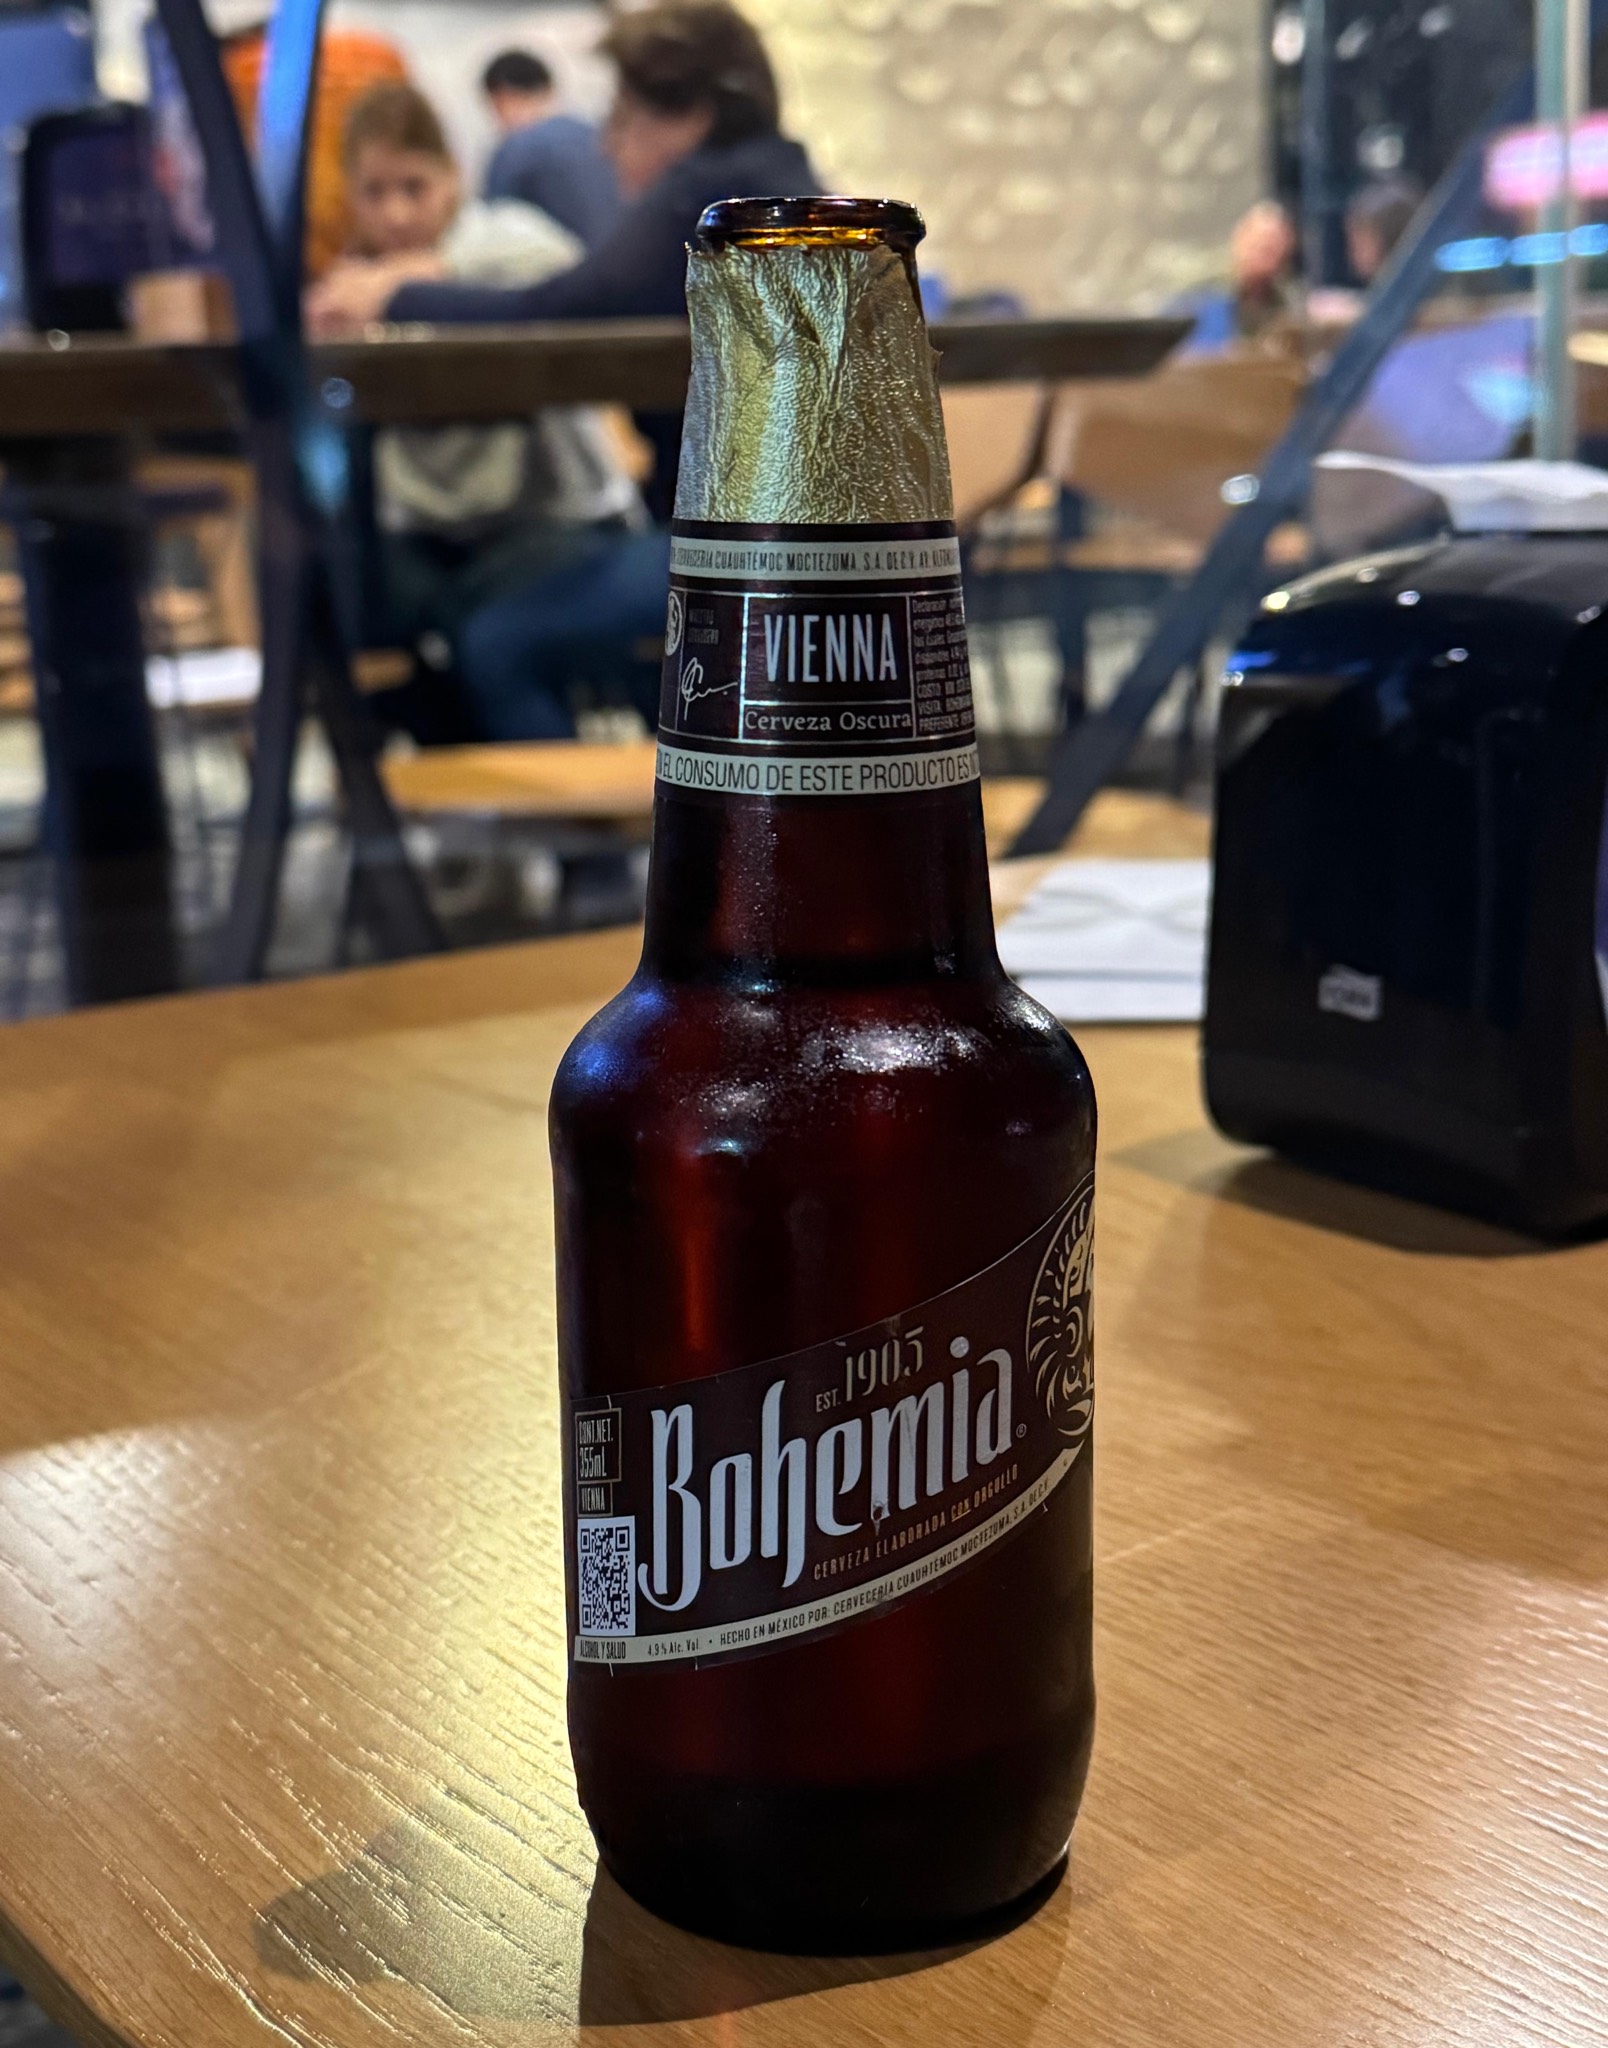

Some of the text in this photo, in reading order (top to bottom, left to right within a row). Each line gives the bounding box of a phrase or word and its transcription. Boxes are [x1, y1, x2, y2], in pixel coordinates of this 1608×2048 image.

[764, 613, 897, 682] VIENNA
[744, 710, 913, 732] Cerveza Oscura
[663, 753, 673, 779] EL
[675, 756, 761, 790] CONSUMO
[766, 765, 794, 791] DE
[800, 765, 854, 792] ESTE
[859, 756, 956, 791] PRODUCTO
[957, 753, 970, 780] ES
[815, 1325, 924, 1413] EST. 1905
[581, 1487, 606, 1512] VIENNA
[637, 1335, 1013, 1612] Bohemia
[814, 1547, 870, 1581] CERVEZA
[876, 1511, 946, 1558] ELABORADA
[973, 1463, 1019, 1508] ORGULLO
[600, 1641, 606, 1659] Y
[606, 1641, 626, 1660] SALUD
[669, 1641, 684, 1654] Alc.
[720, 1629, 751, 1646] HECHO
[753, 1625, 765, 1639] EN
[768, 1612, 805, 1635] MÉXICO
[808, 1607, 831, 1624] POR:
[833, 1580, 894, 1616] CERVECERÍA
